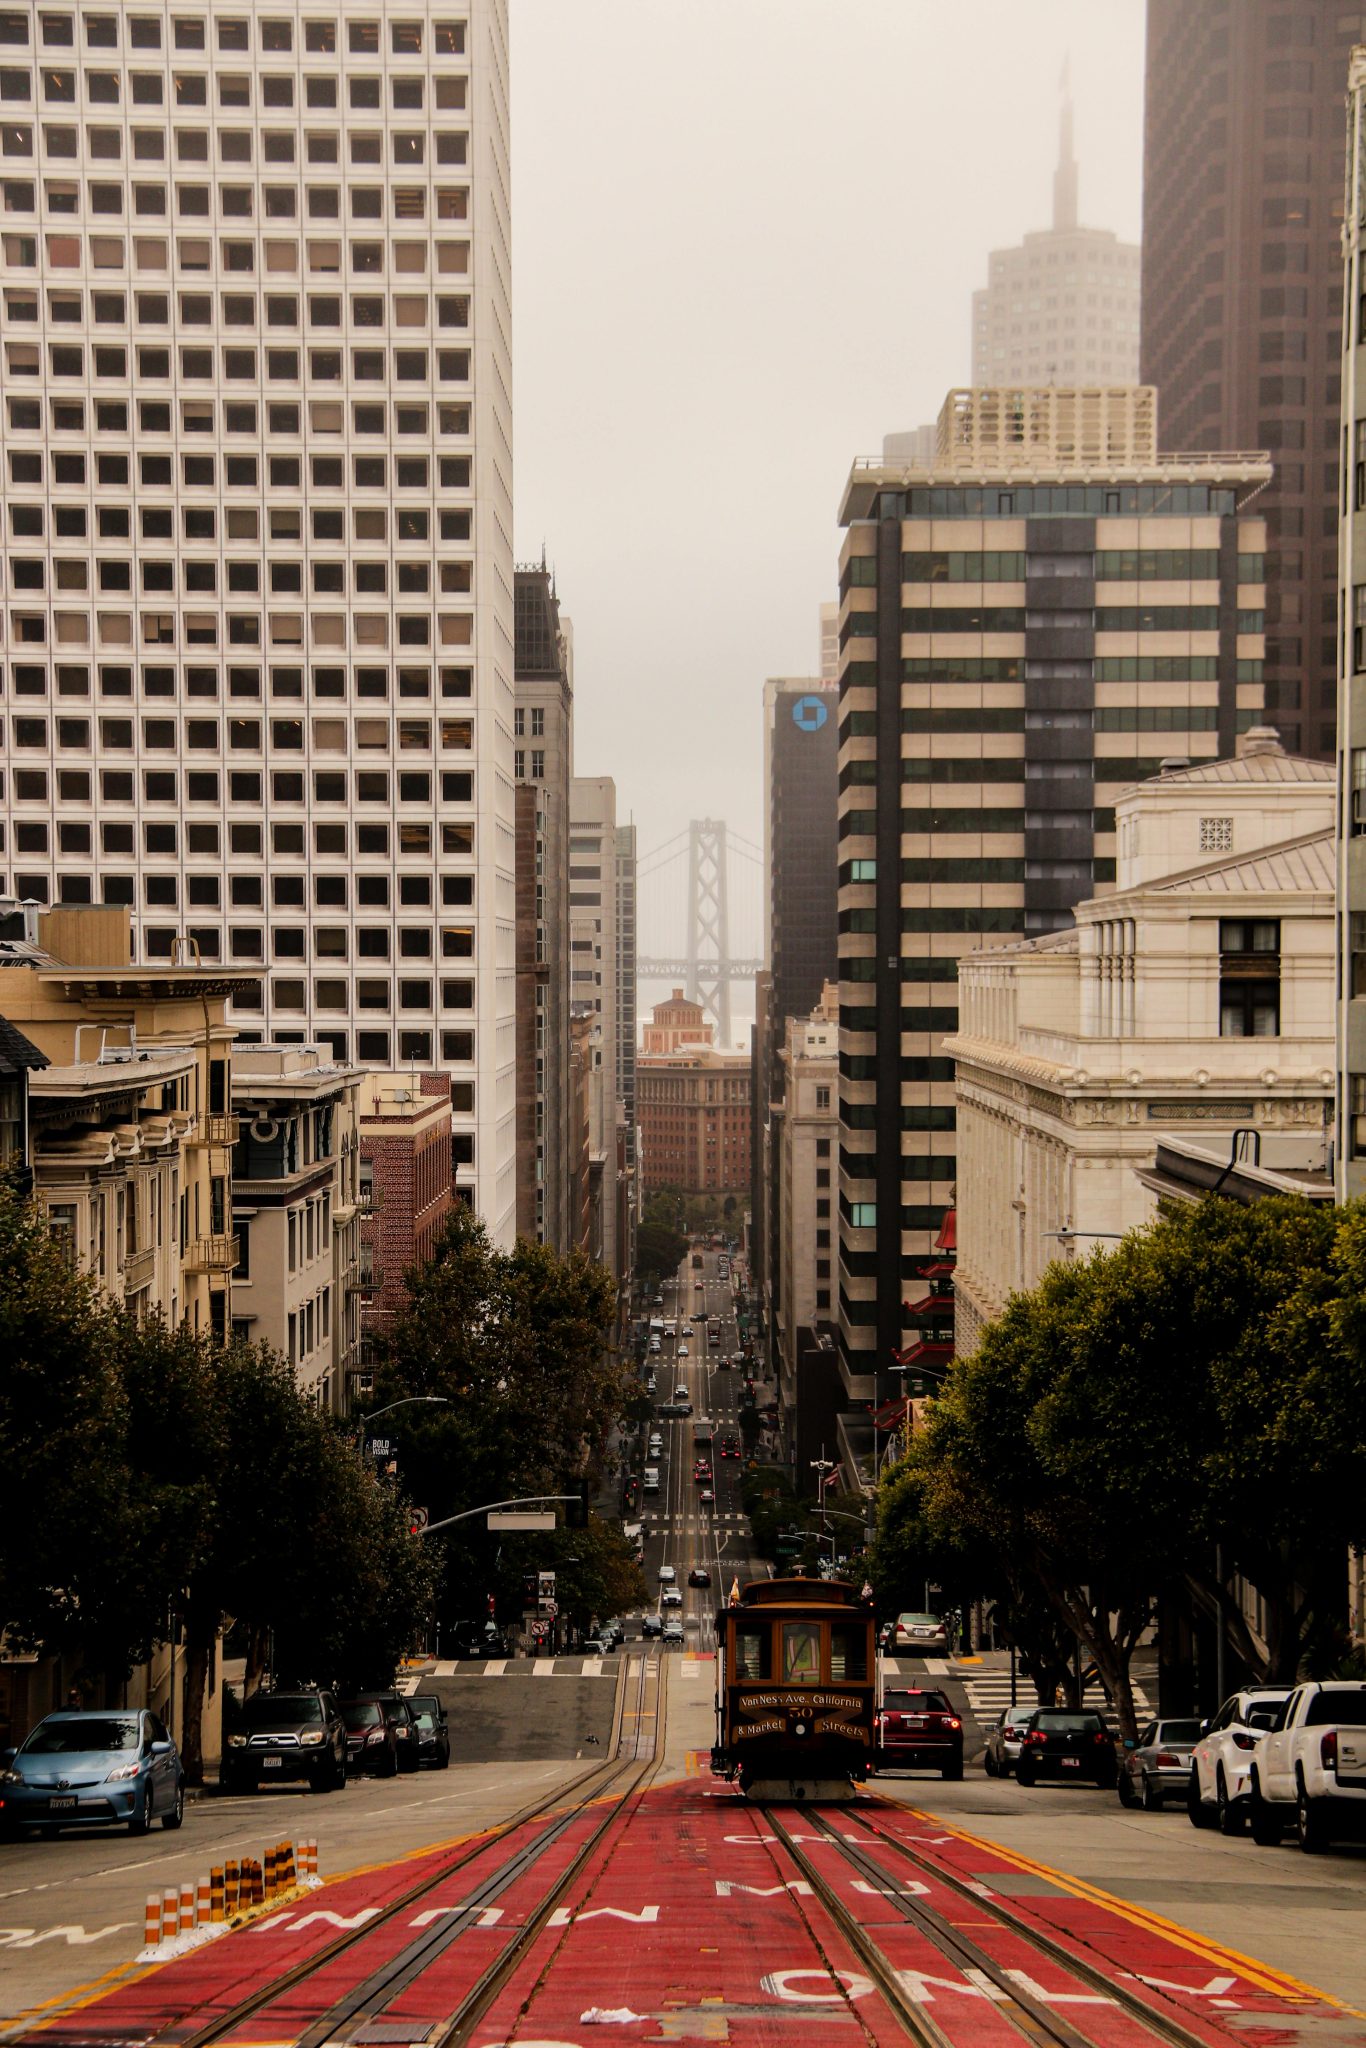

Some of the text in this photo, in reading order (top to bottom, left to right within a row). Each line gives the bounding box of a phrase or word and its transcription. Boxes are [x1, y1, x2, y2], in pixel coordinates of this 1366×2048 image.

[372, 1439, 390, 1449] BOLD
[372, 1448, 390, 1456] VISION
[741, 1697, 759, 1707] Van
[759, 1695, 783, 1705] Ness
[812, 1694, 862, 1708] California
[738, 1720, 863, 1736] & Market Streets
[723, 1834, 954, 1845] ONLY
[759, 1969, 1242, 2008] ONLY
